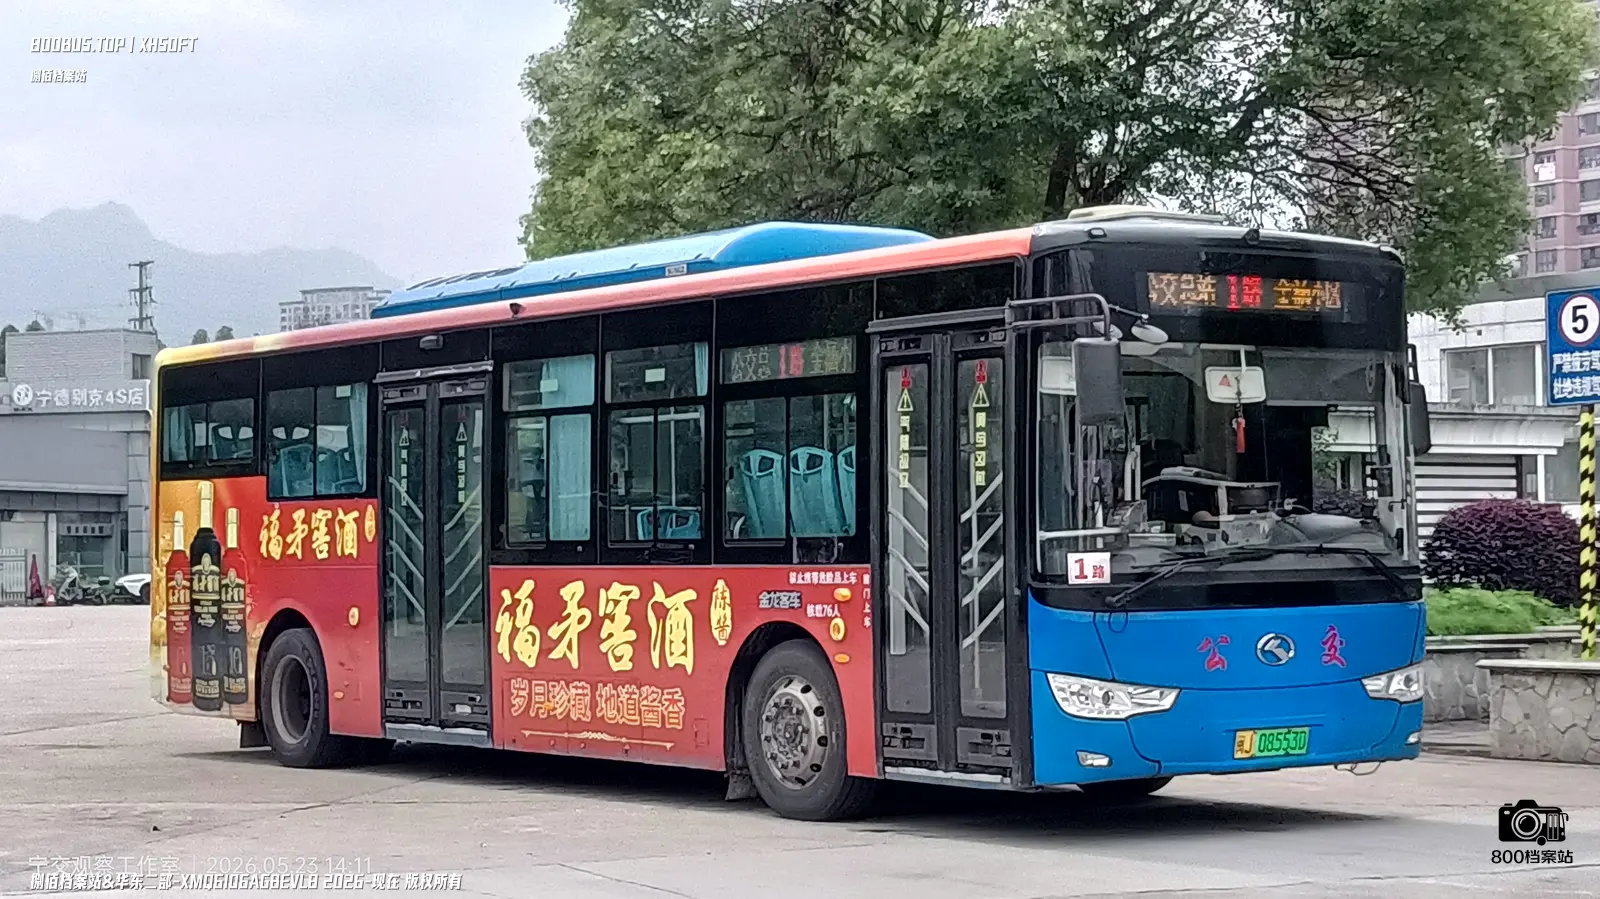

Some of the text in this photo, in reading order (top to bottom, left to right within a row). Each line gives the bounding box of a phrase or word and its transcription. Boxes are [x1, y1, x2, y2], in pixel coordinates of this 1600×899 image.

[1572, 304, 1589, 334] 5
[36, 388, 144, 407] 宁德别克4S店
[759, 590, 801, 609] 金龙客车
[494, 578, 698, 676] 福矛窖酒
[510, 677, 686, 730] 岁月珍藏 地道酱香
